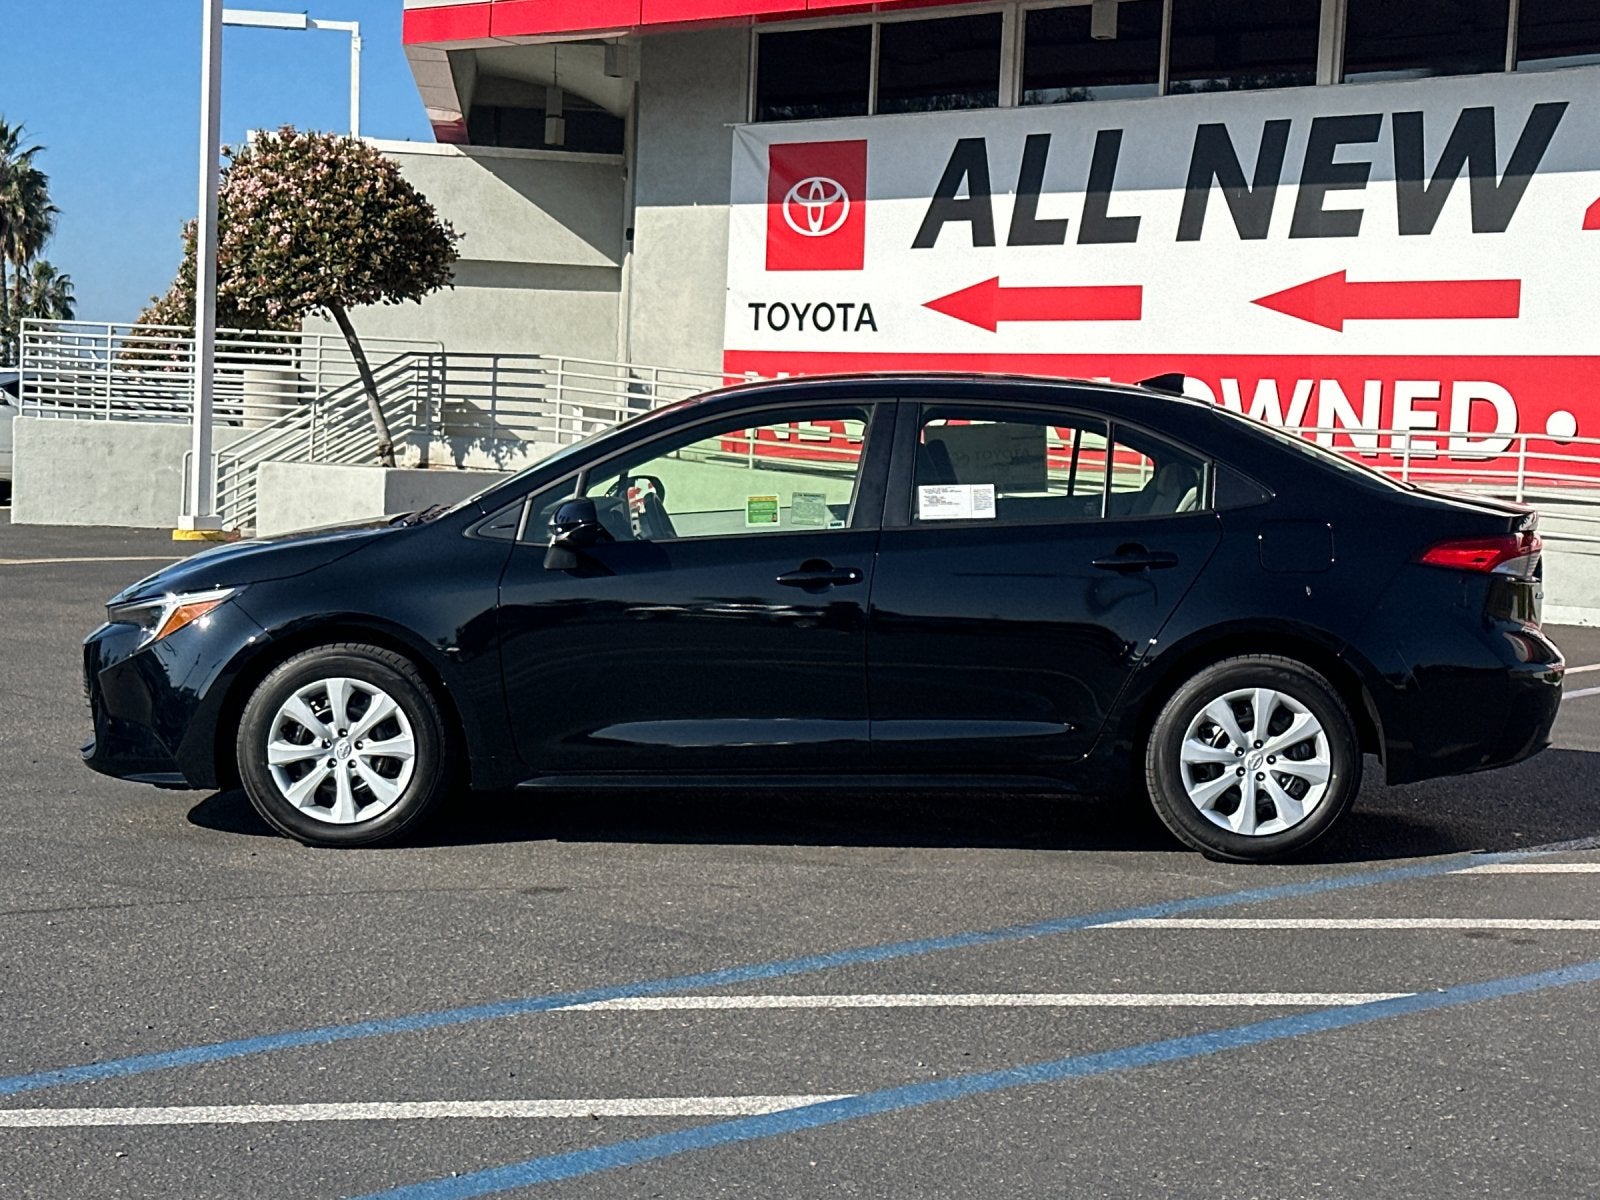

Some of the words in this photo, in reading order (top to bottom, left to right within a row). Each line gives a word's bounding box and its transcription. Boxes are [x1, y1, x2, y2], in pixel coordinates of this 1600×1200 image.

[910, 128, 1142, 249] ALL
[1175, 101, 1570, 242] NEW
[748, 301, 878, 333] TOYOTA
[1183, 376, 1518, 460] WNED
